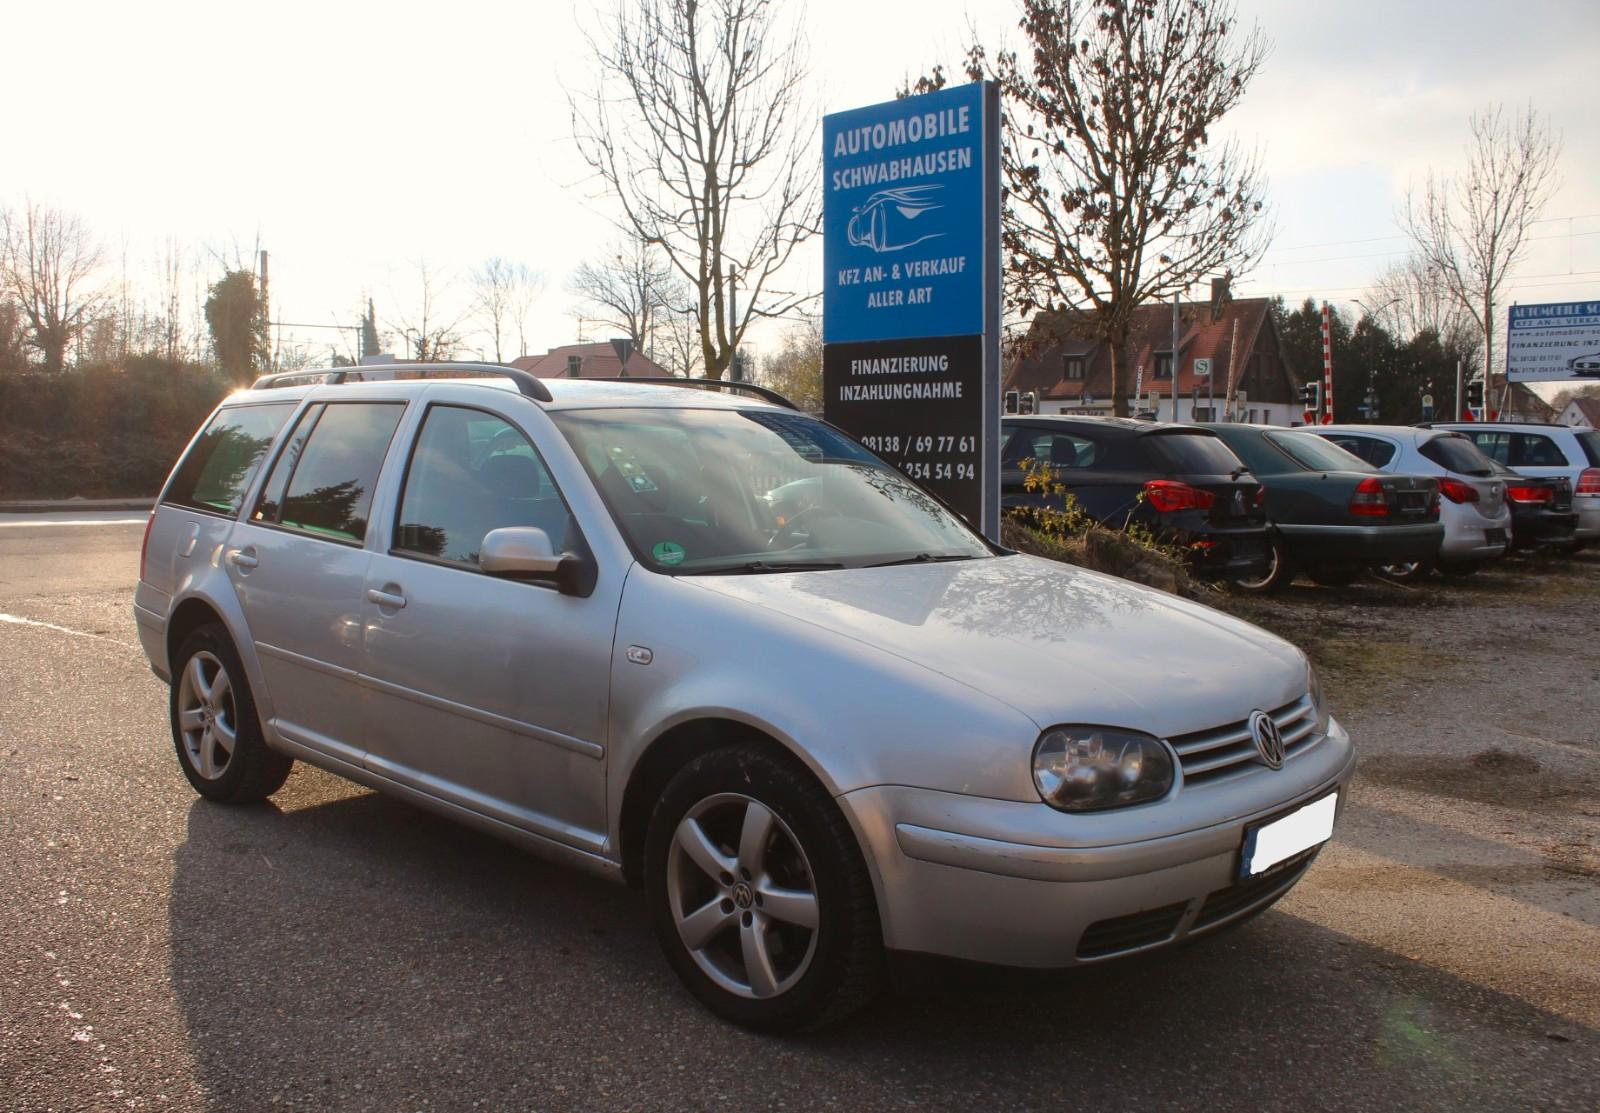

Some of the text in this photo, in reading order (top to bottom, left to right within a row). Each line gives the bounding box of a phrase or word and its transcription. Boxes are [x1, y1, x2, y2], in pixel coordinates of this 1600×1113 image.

[833, 106, 970, 158] AUTOMOBILE
[833, 147, 971, 191] SCHWABHAUSEN
[838, 256, 966, 286] KFZ AN- & VERKAUF
[867, 287, 933, 308] ALLER ART
[851, 355, 949, 376] FINANZIERUNG
[840, 382, 963, 401] INZAHLUNGNAHME
[904, 436, 911, 456] /
[916, 436, 932, 453] 69
[938, 436, 954, 453] 77
[959, 436, 976, 453] 61
[906, 463, 930, 480] 254
[935, 463, 952, 480] 54
[957, 463, 975, 480] 94
